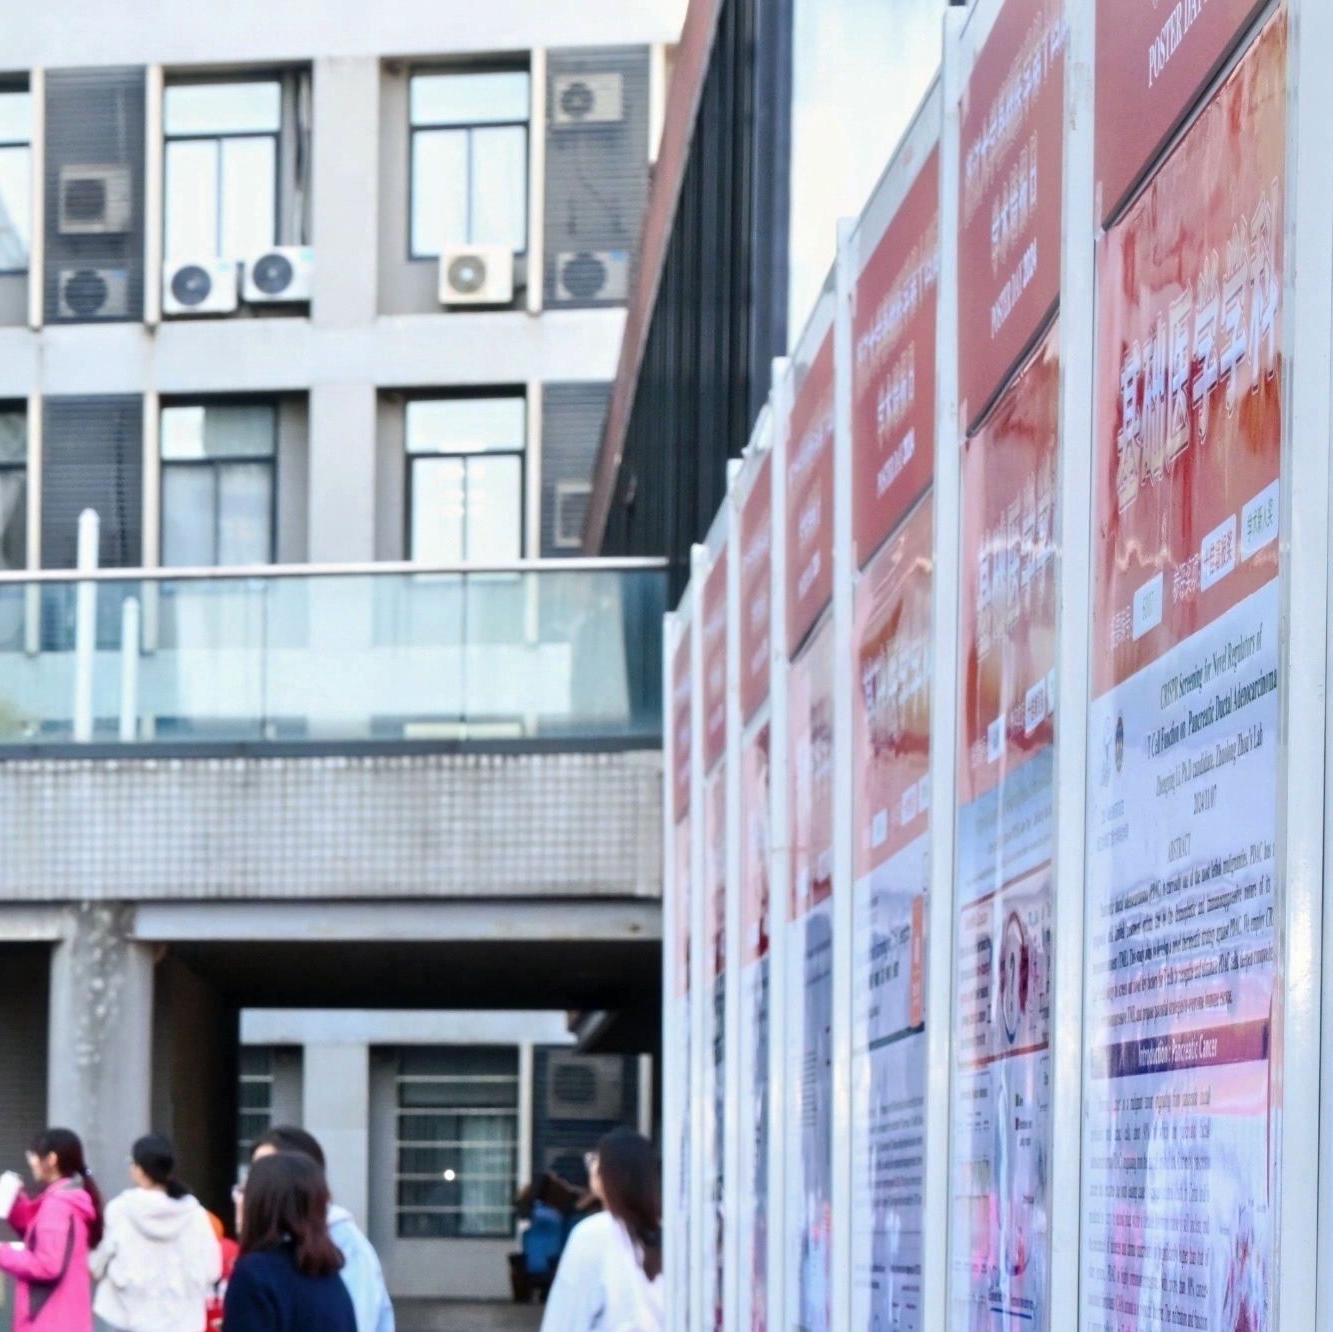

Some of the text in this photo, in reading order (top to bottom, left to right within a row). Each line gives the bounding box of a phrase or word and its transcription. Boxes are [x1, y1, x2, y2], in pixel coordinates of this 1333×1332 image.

[1148, 12, 1184, 88] POSTER
[1117, 176, 1279, 513] 基础医学学科
[1179, 658, 1202, 705] Screening
[1203, 653, 1211, 685] for
[1256, 620, 1263, 652] of
[1161, 718, 1178, 751] Function
[1188, 698, 1214, 736] Pancreatic
[1215, 687, 1232, 722] Ductal
[1233, 660, 1276, 711] Adenocarcinoma
[1167, 832, 1190, 863] ABSTRACT
[1172, 1033, 1197, 1062] Pancreatic
[1199, 1030, 1217, 1058] Cancer
